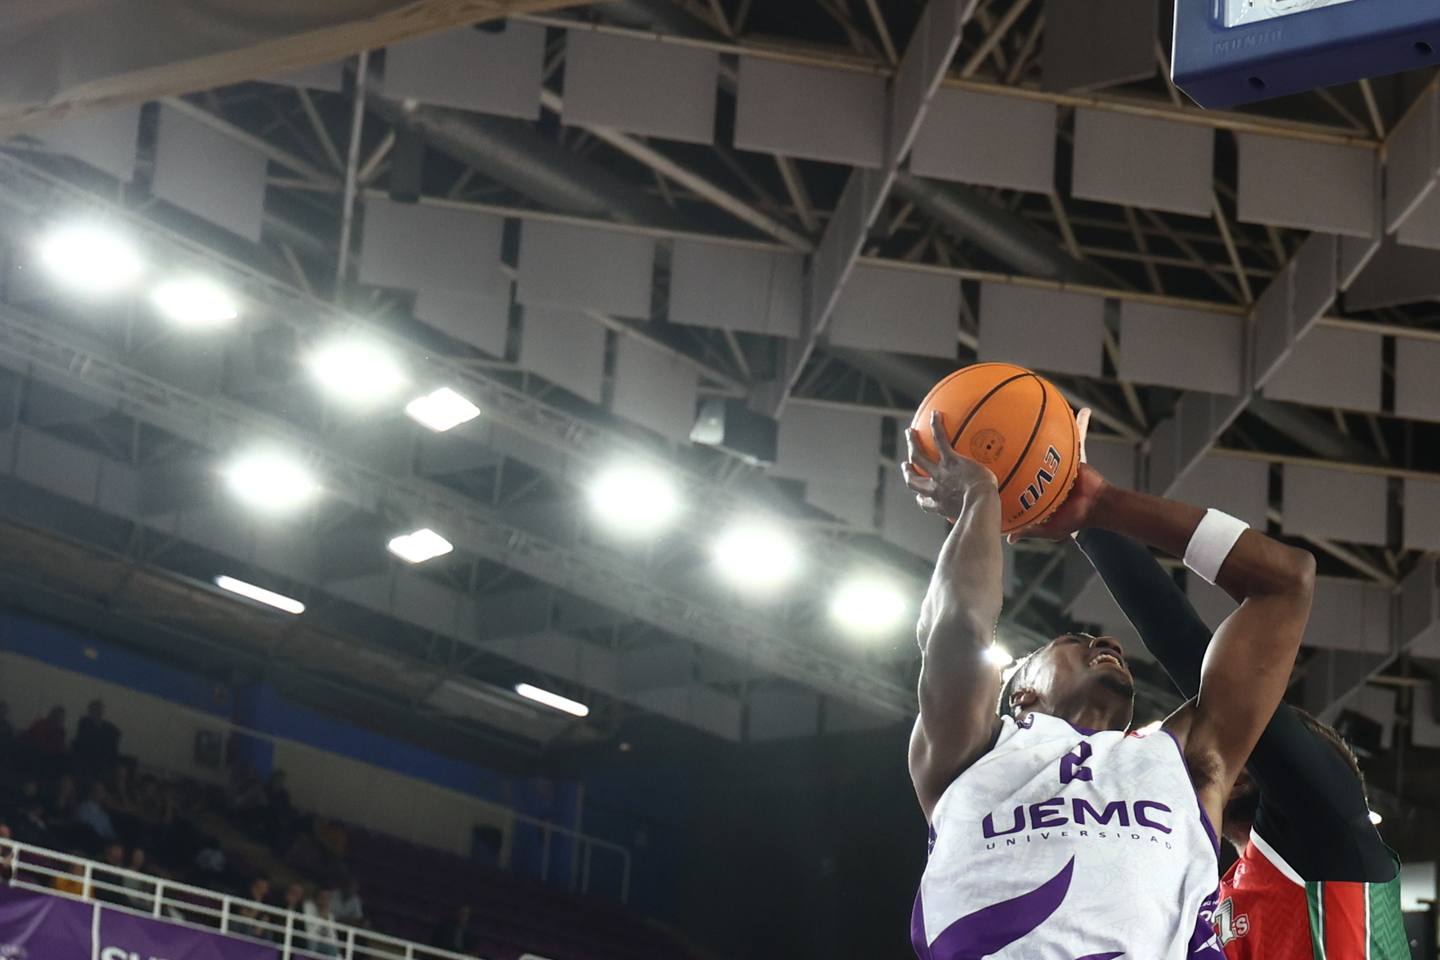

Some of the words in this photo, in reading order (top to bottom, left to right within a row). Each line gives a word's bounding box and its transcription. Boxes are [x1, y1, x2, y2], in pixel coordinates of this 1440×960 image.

[1018, 444, 1062, 512] EVO
[981, 797, 1173, 840] UEMC
[985, 830, 1173, 850] UNIVERSIDAD
